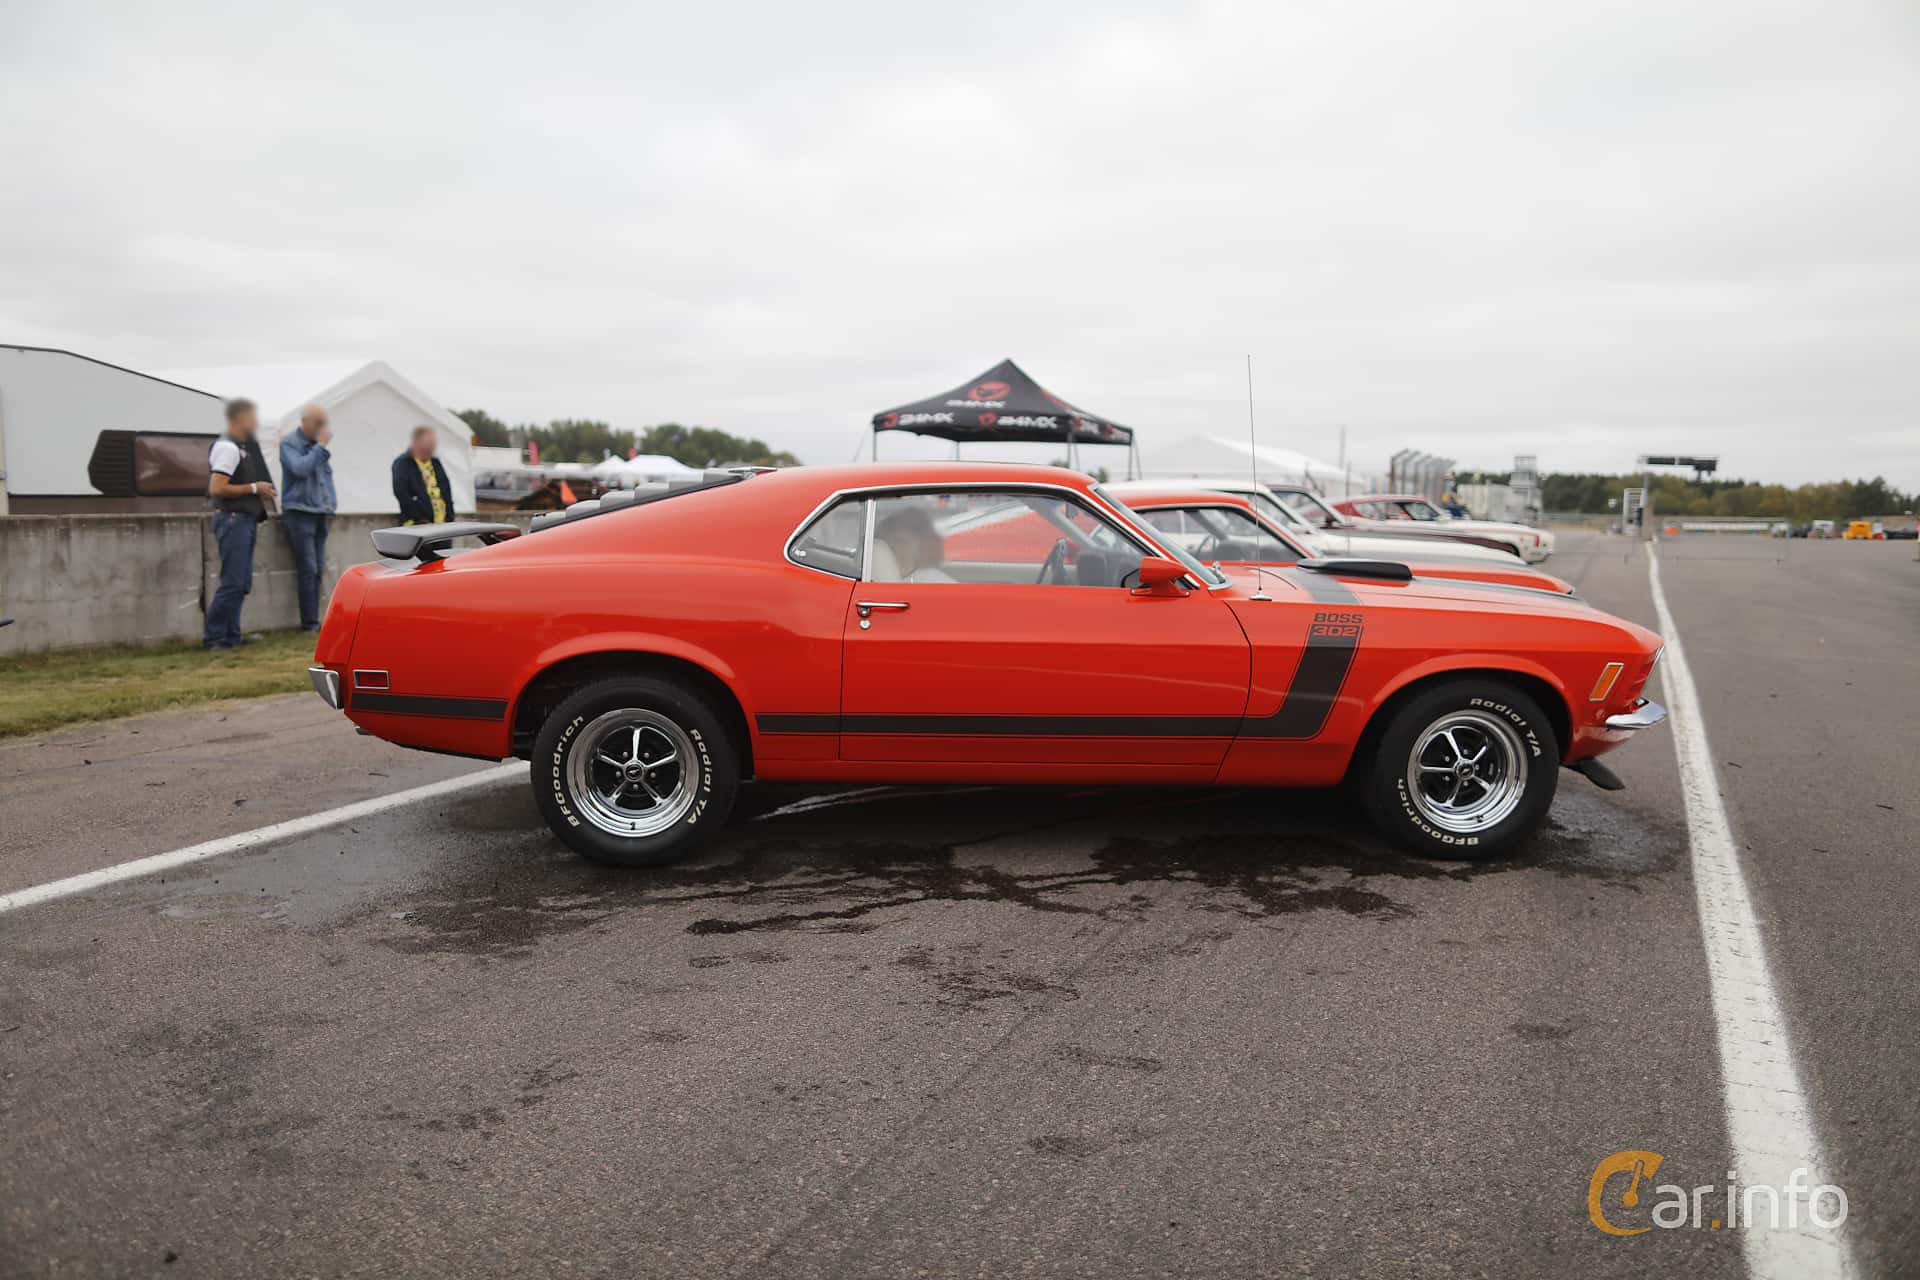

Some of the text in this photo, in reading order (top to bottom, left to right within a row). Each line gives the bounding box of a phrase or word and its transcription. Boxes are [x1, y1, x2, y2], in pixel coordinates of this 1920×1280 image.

[1312, 625, 1358, 637] 302
[1313, 612, 1363, 624] BOSS
[1470, 698, 1542, 757] Radial T/A
[552, 716, 584, 827] BFGoodrich
[687, 728, 713, 825] Radial T/A
[1397, 778, 1480, 846] BFGoodrich
